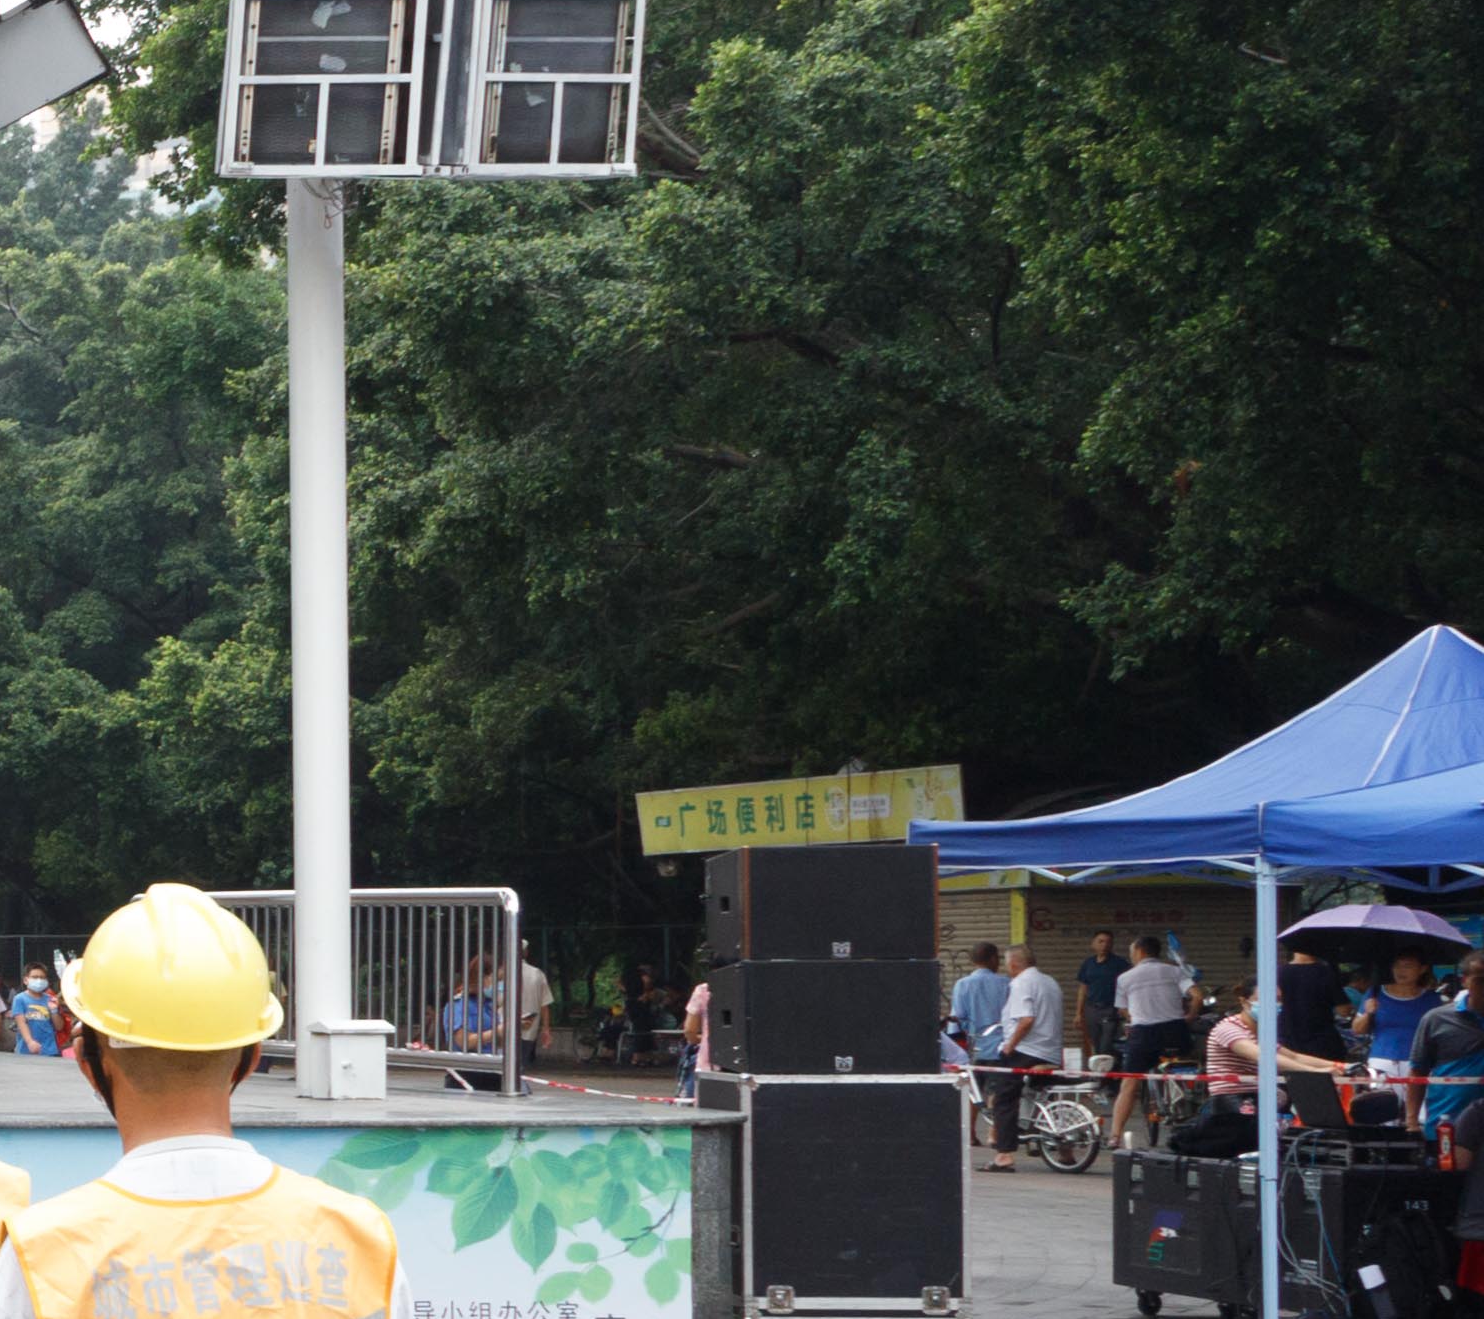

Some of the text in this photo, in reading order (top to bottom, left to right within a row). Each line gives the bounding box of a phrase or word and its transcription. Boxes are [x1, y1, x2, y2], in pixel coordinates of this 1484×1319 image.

[677, 792, 817, 838] 广场便利店
[1404, 1200, 1429, 1211] 143
